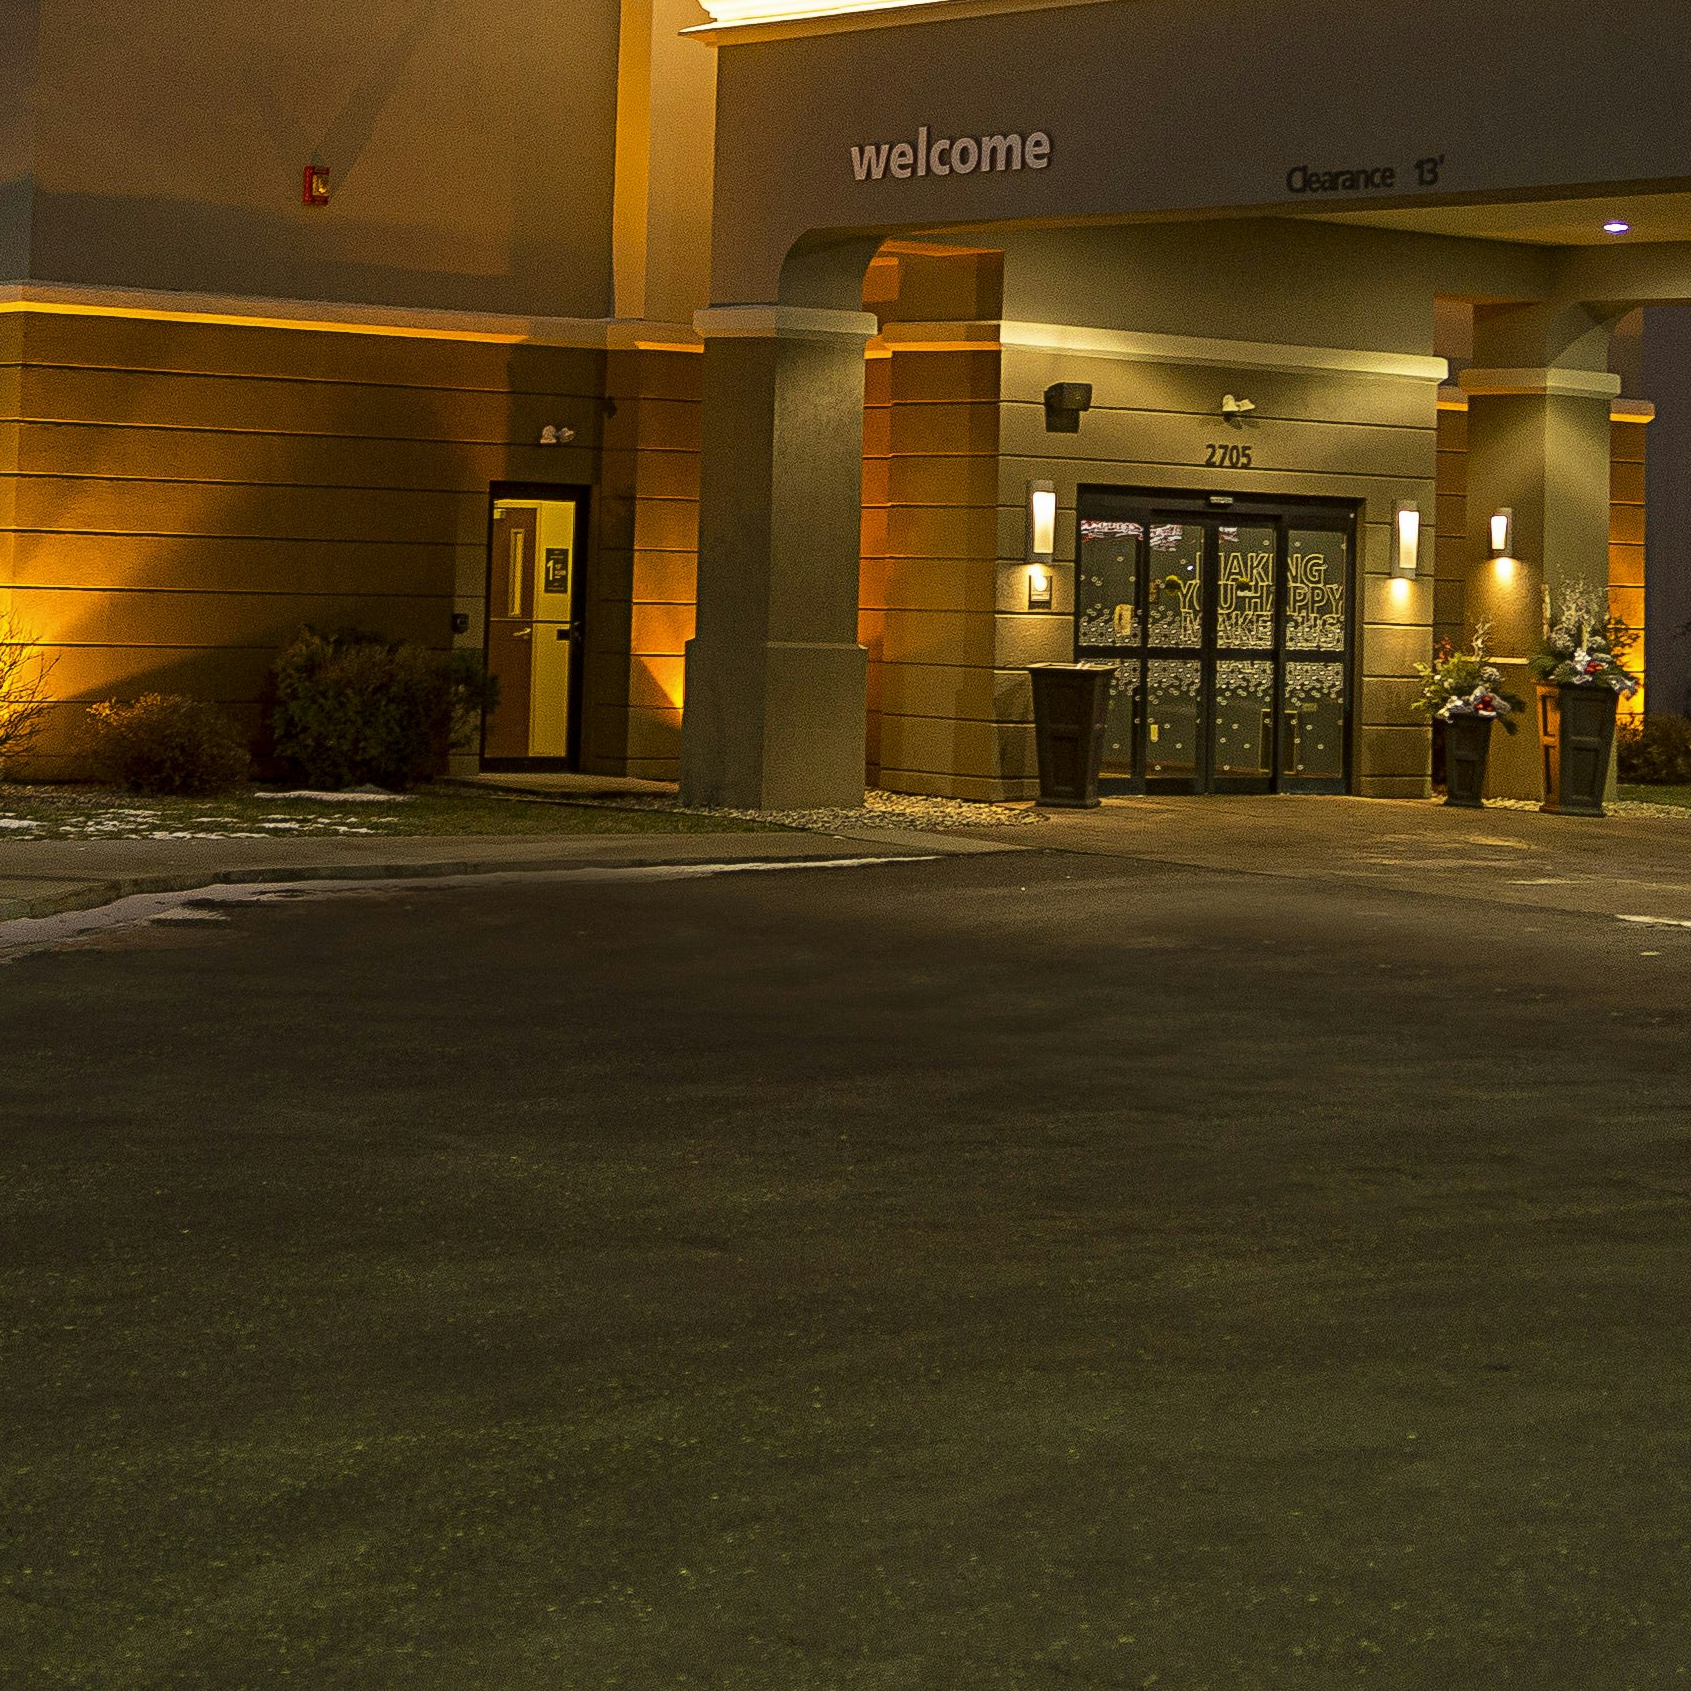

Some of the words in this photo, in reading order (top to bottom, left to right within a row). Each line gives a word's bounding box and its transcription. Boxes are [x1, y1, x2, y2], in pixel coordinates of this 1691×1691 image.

[850, 126, 1052, 181] welcome
[1285, 164, 1397, 194] Clearance
[1204, 443, 1253, 468] 2705
[1181, 609, 1298, 646] MAKE
